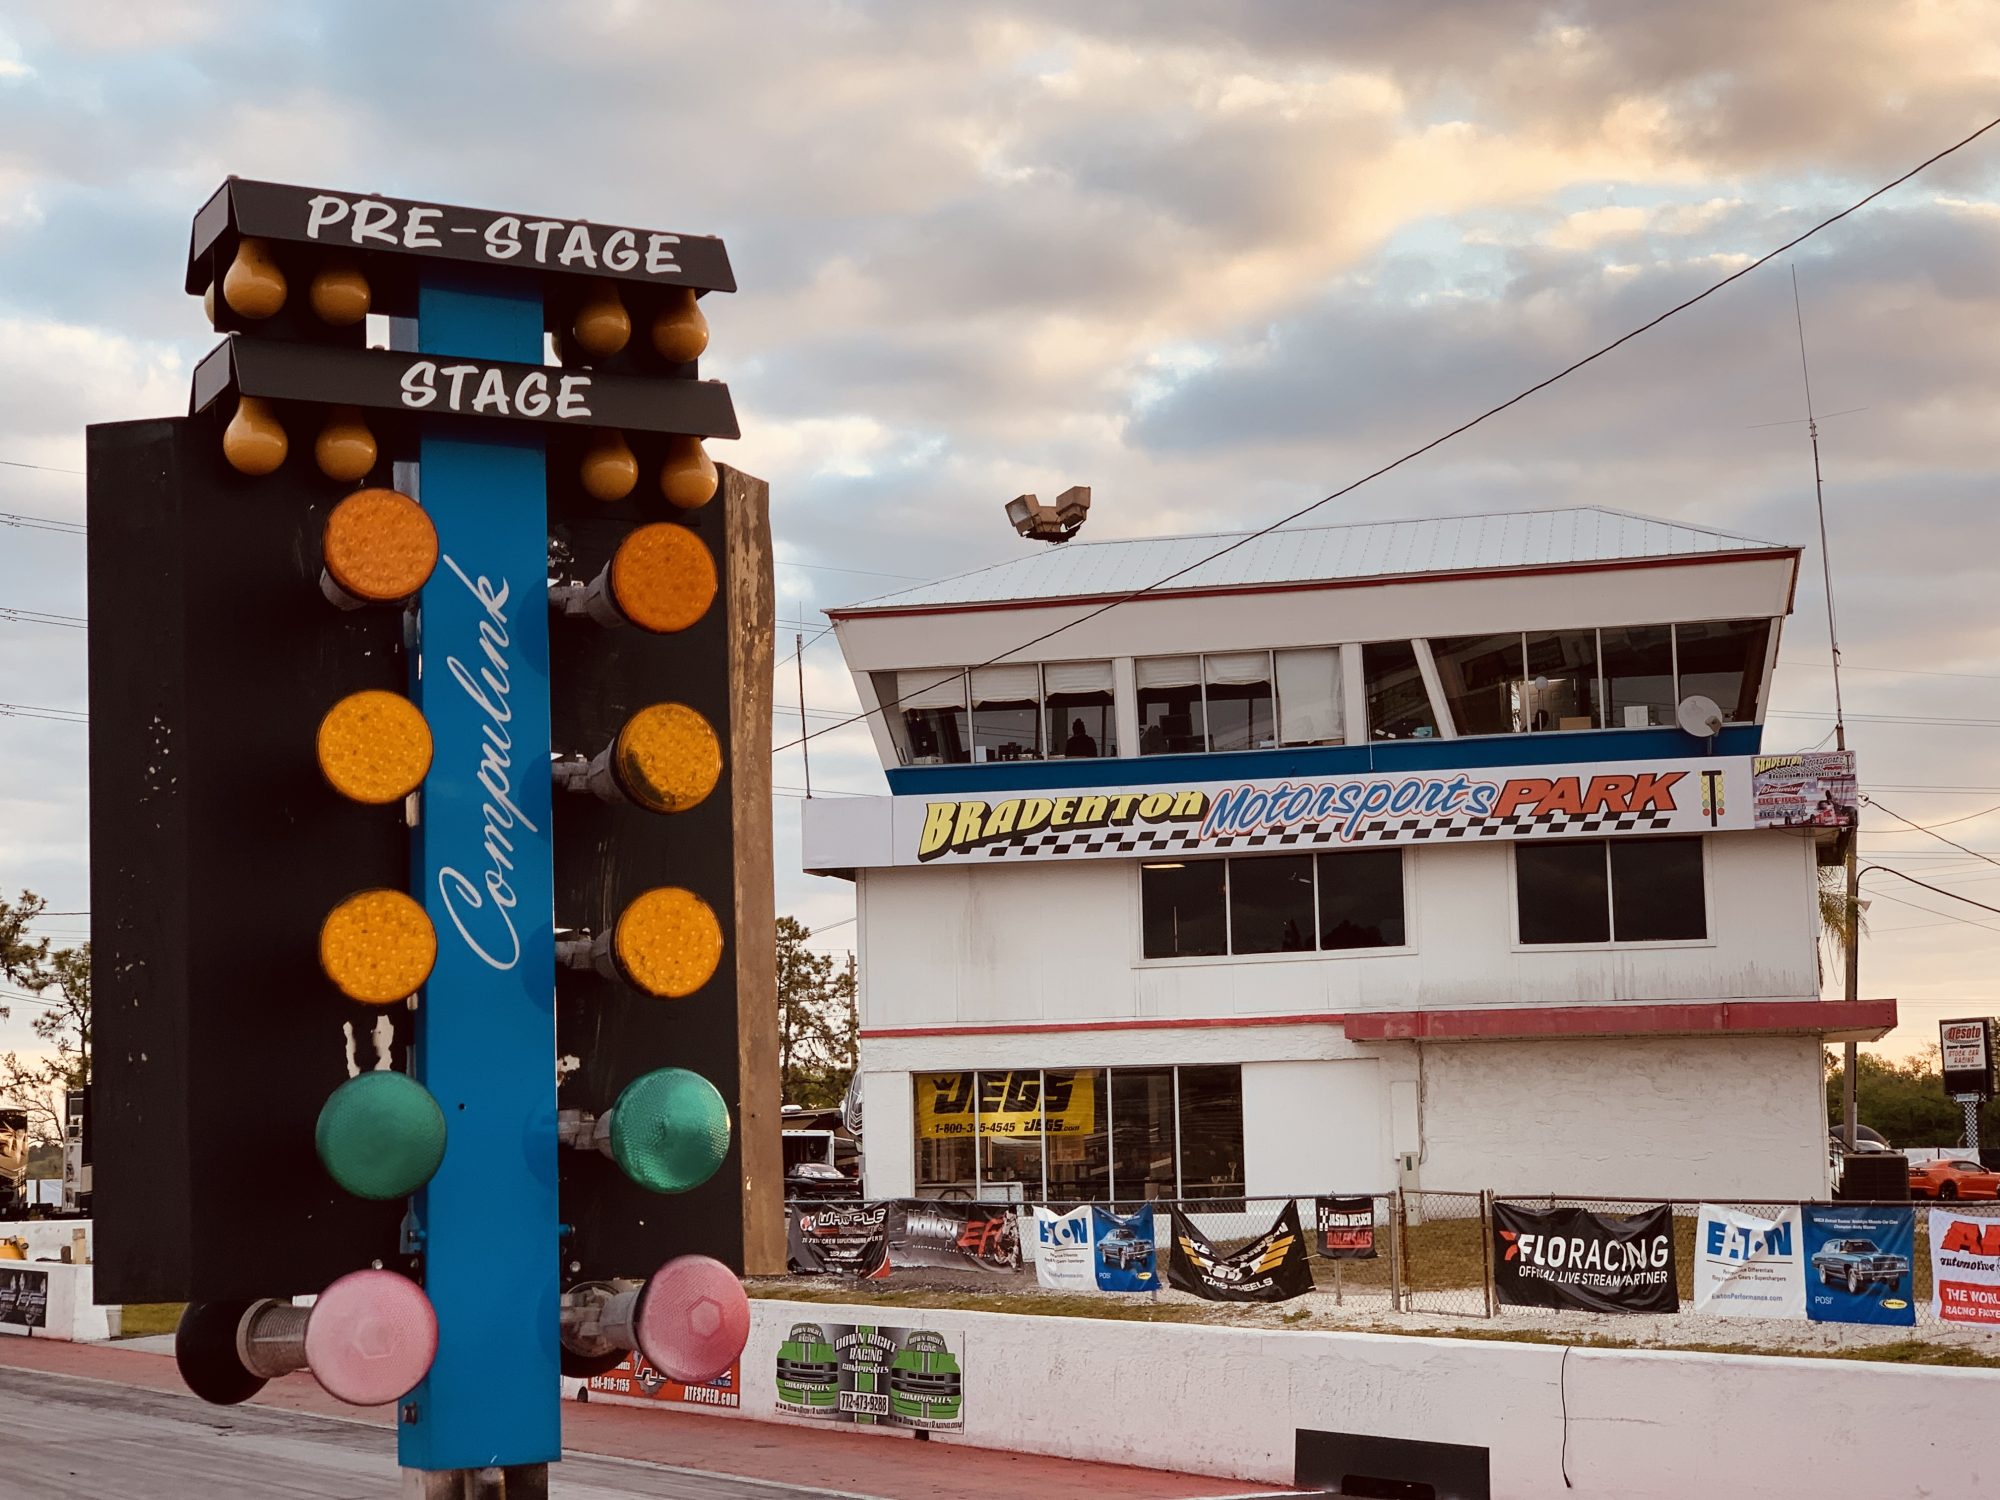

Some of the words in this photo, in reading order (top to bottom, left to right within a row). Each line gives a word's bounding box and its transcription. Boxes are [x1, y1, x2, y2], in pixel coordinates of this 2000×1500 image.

[306, 196, 682, 274] PRE-STAGE
[401, 361, 592, 418] STAGE
[439, 554, 538, 970] Compulink
[917, 791, 1209, 863] BRADENTON
[1201, 774, 1499, 842] Motorsports
[1491, 771, 1690, 818] PARK
[933, 1071, 1075, 1114] JEGS
[935, 1122, 1016, 1133] 1-800-35-4545
[1558, 1270, 1580, 1284] LIVE
[1581, 1273, 1620, 1287] STREAM
[1946, 1288, 1969, 1302] THE
[834, 1332, 865, 1351] DOWN
[867, 1333, 898, 1354] RIGHT
[849, 1346, 883, 1362] RACING
[841, 1363, 889, 1374] COMPOSITES
[784, 1380, 830, 1392] COMPOSITES
[841, 1393, 887, 1412] 772-473-9288
[900, 1392, 951, 1404] COMPOSITES
